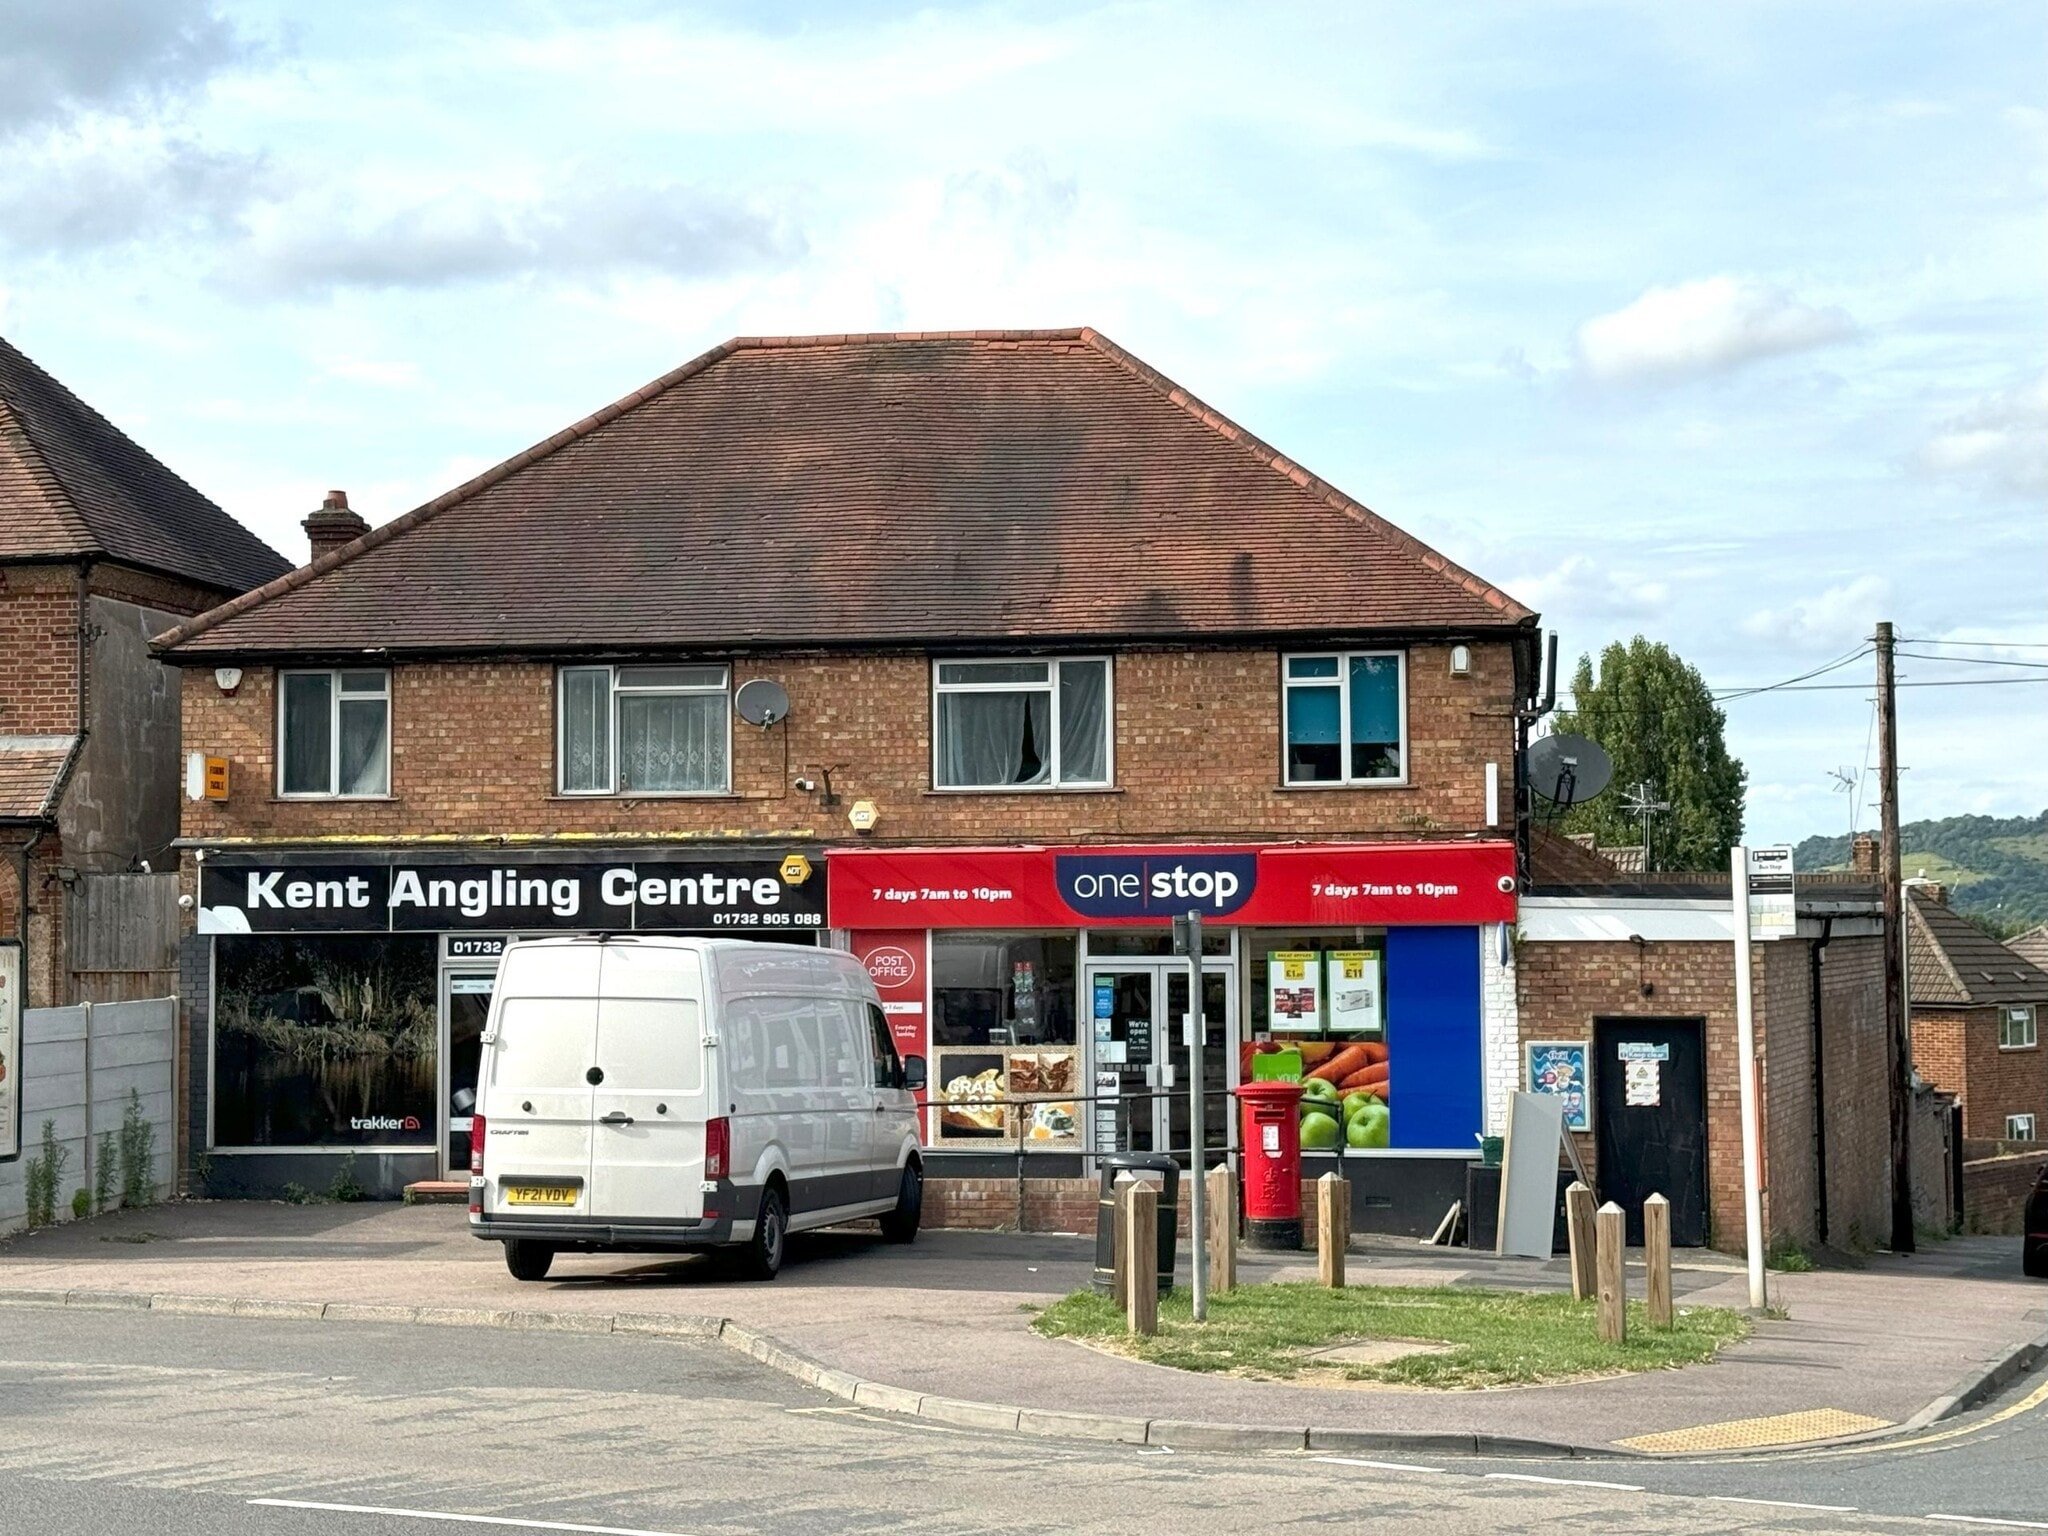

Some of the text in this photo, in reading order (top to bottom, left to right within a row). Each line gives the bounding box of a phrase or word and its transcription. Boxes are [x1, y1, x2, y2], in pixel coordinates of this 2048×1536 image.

[786, 865, 801, 876] ADT
[1074, 864, 1239, 907] one stop
[1312, 883, 1459, 899] 7 days 7am to 10pm
[247, 868, 781, 918] Kent Angling Centre
[872, 888, 1013, 903] 7 days 7am to 10pm
[713, 913, 822, 925] 01732 905 088
[453, 941, 502, 953] 01732
[875, 955, 904, 966] POST
[868, 966, 908, 977] OFFICE
[1345, 968, 1363, 978] £11
[894, 1024, 917, 1032] Everyday
[1128, 1020, 1149, 1028] We're
[1130, 1028, 1147, 1036] open
[948, 1079, 996, 1095] GRAB
[967, 1095, 996, 1113] GO
[350, 1115, 405, 1130] trakker
[515, 1188, 570, 1201] YF21 VDV
